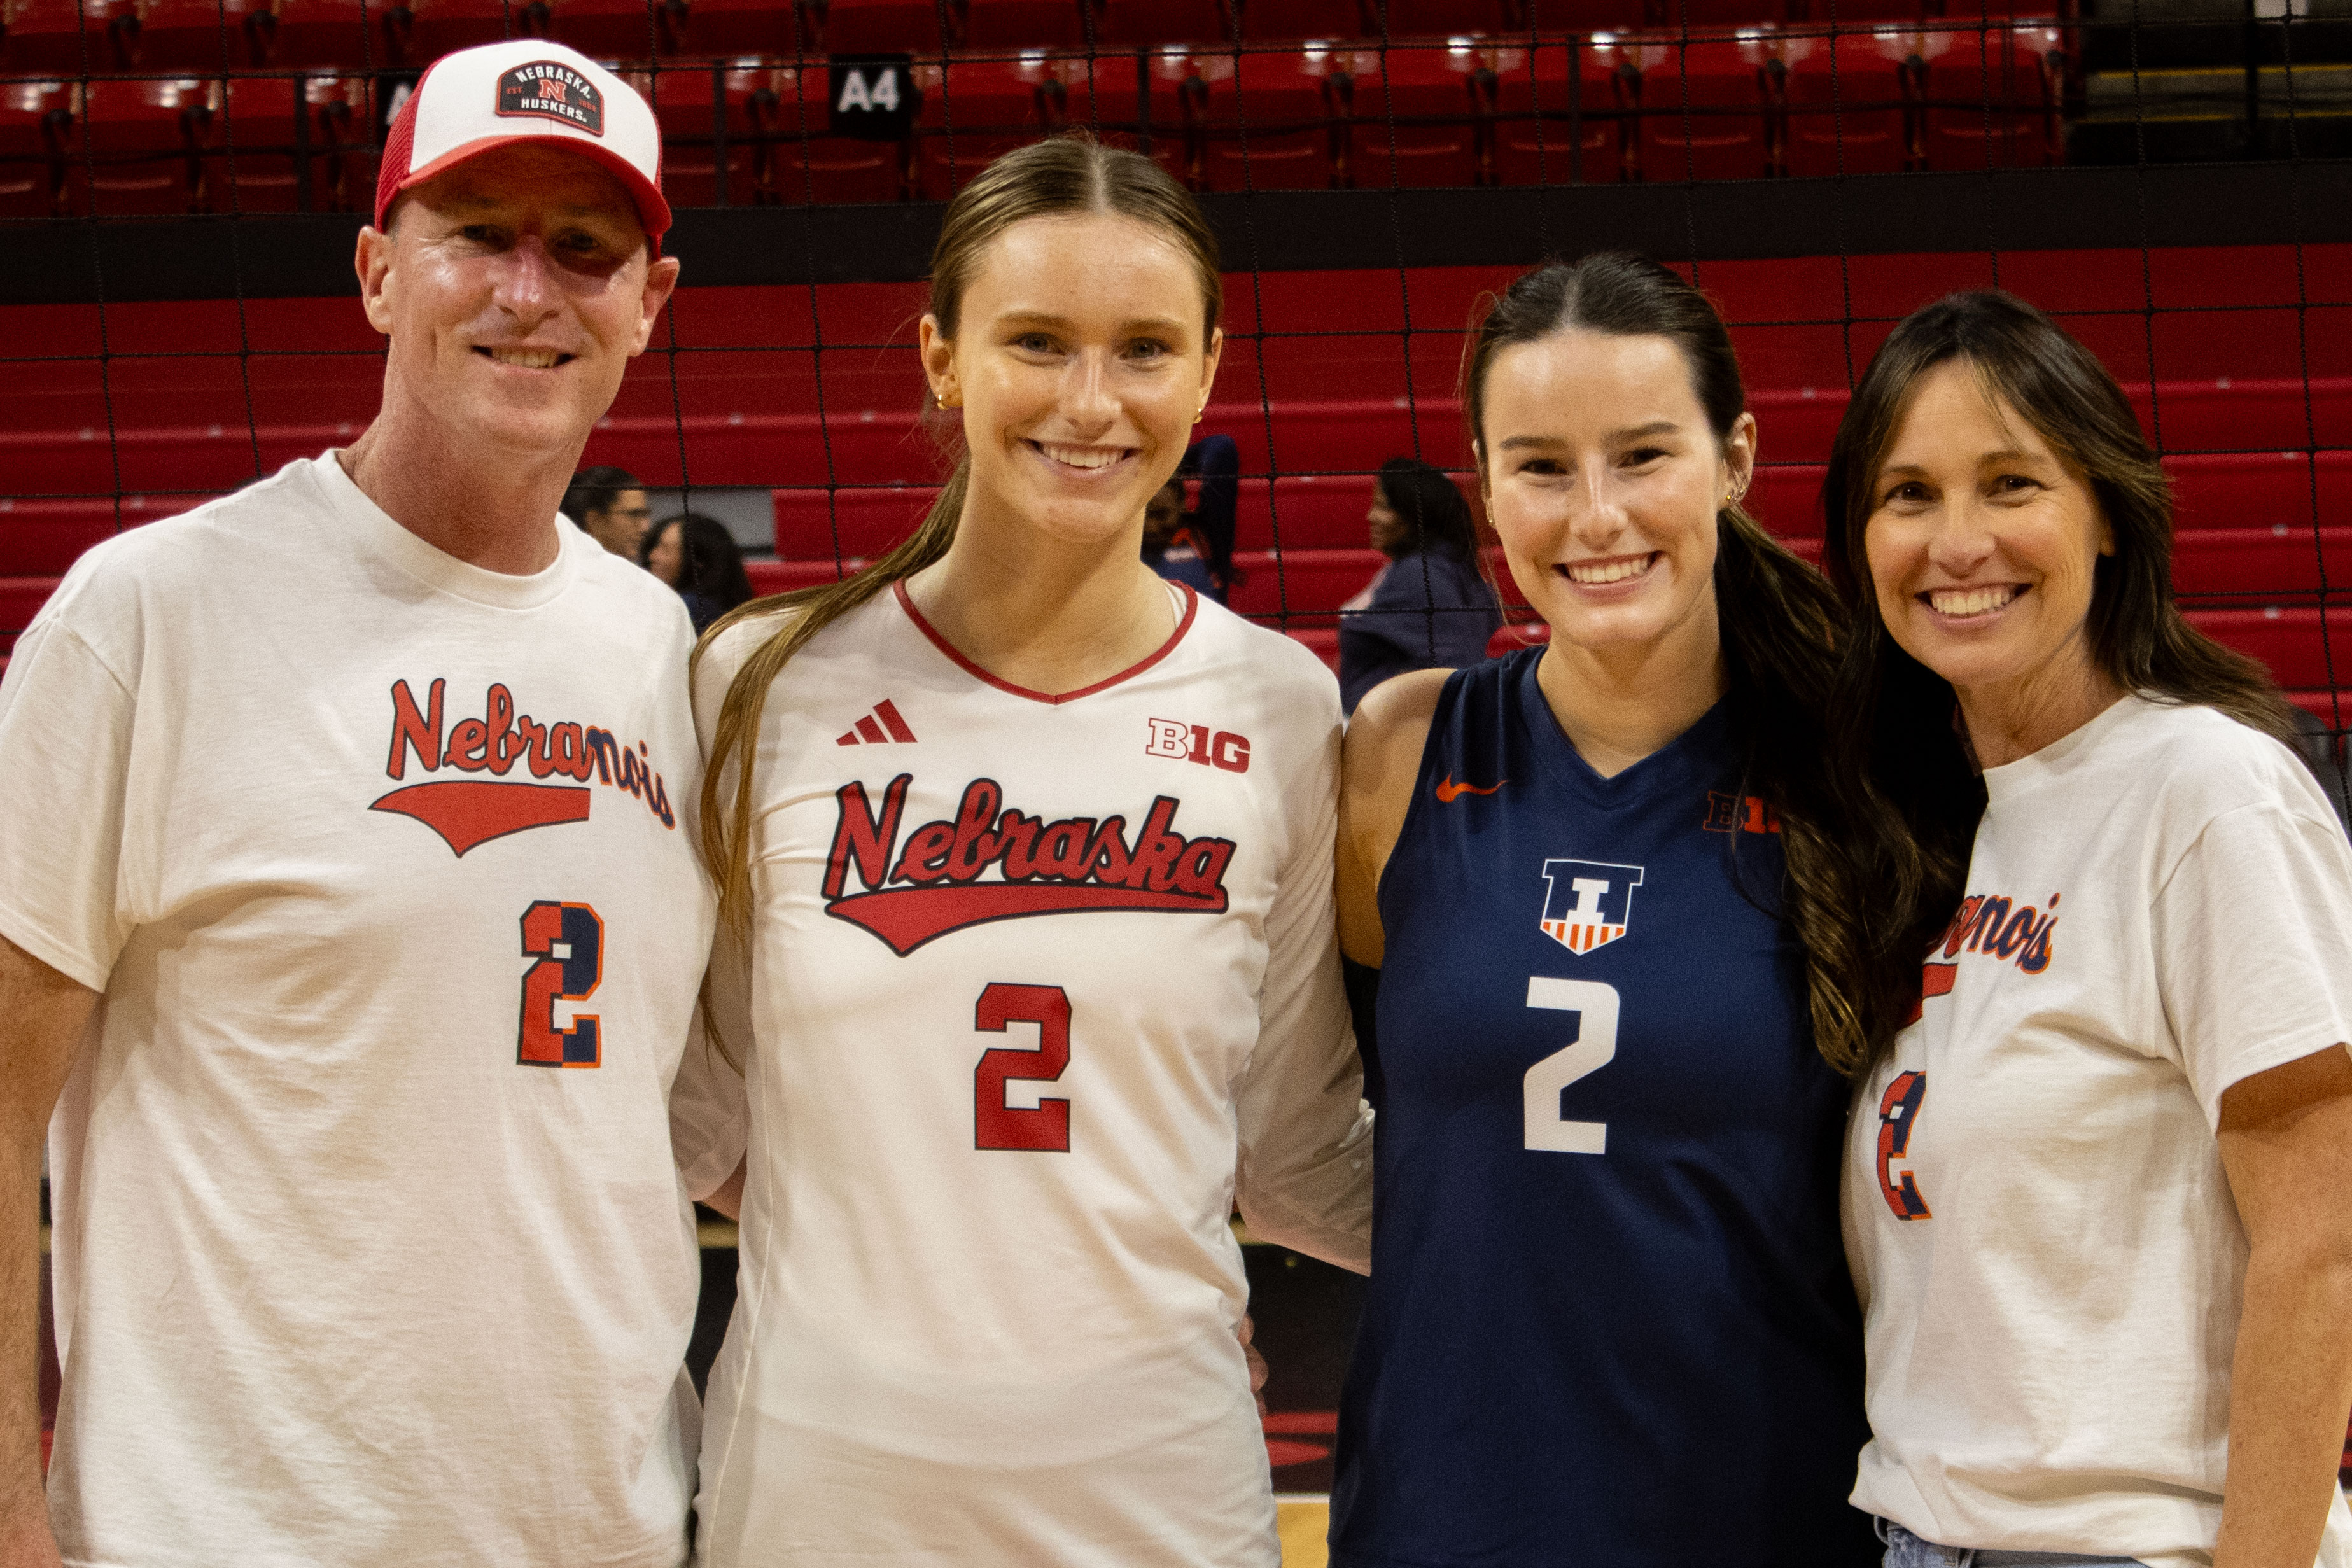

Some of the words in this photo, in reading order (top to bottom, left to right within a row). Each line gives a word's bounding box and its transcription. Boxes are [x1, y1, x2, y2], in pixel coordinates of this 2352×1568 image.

[539, 78, 567, 103] N
[837, 68, 900, 112] A4
[386, 678, 676, 830] Nebranois
[821, 773, 1236, 902] Nebraska
[516, 900, 604, 1068] 2
[974, 982, 1072, 1153] 2
[1523, 976, 1620, 1154] 2
[1876, 1070, 1933, 1221] 2
